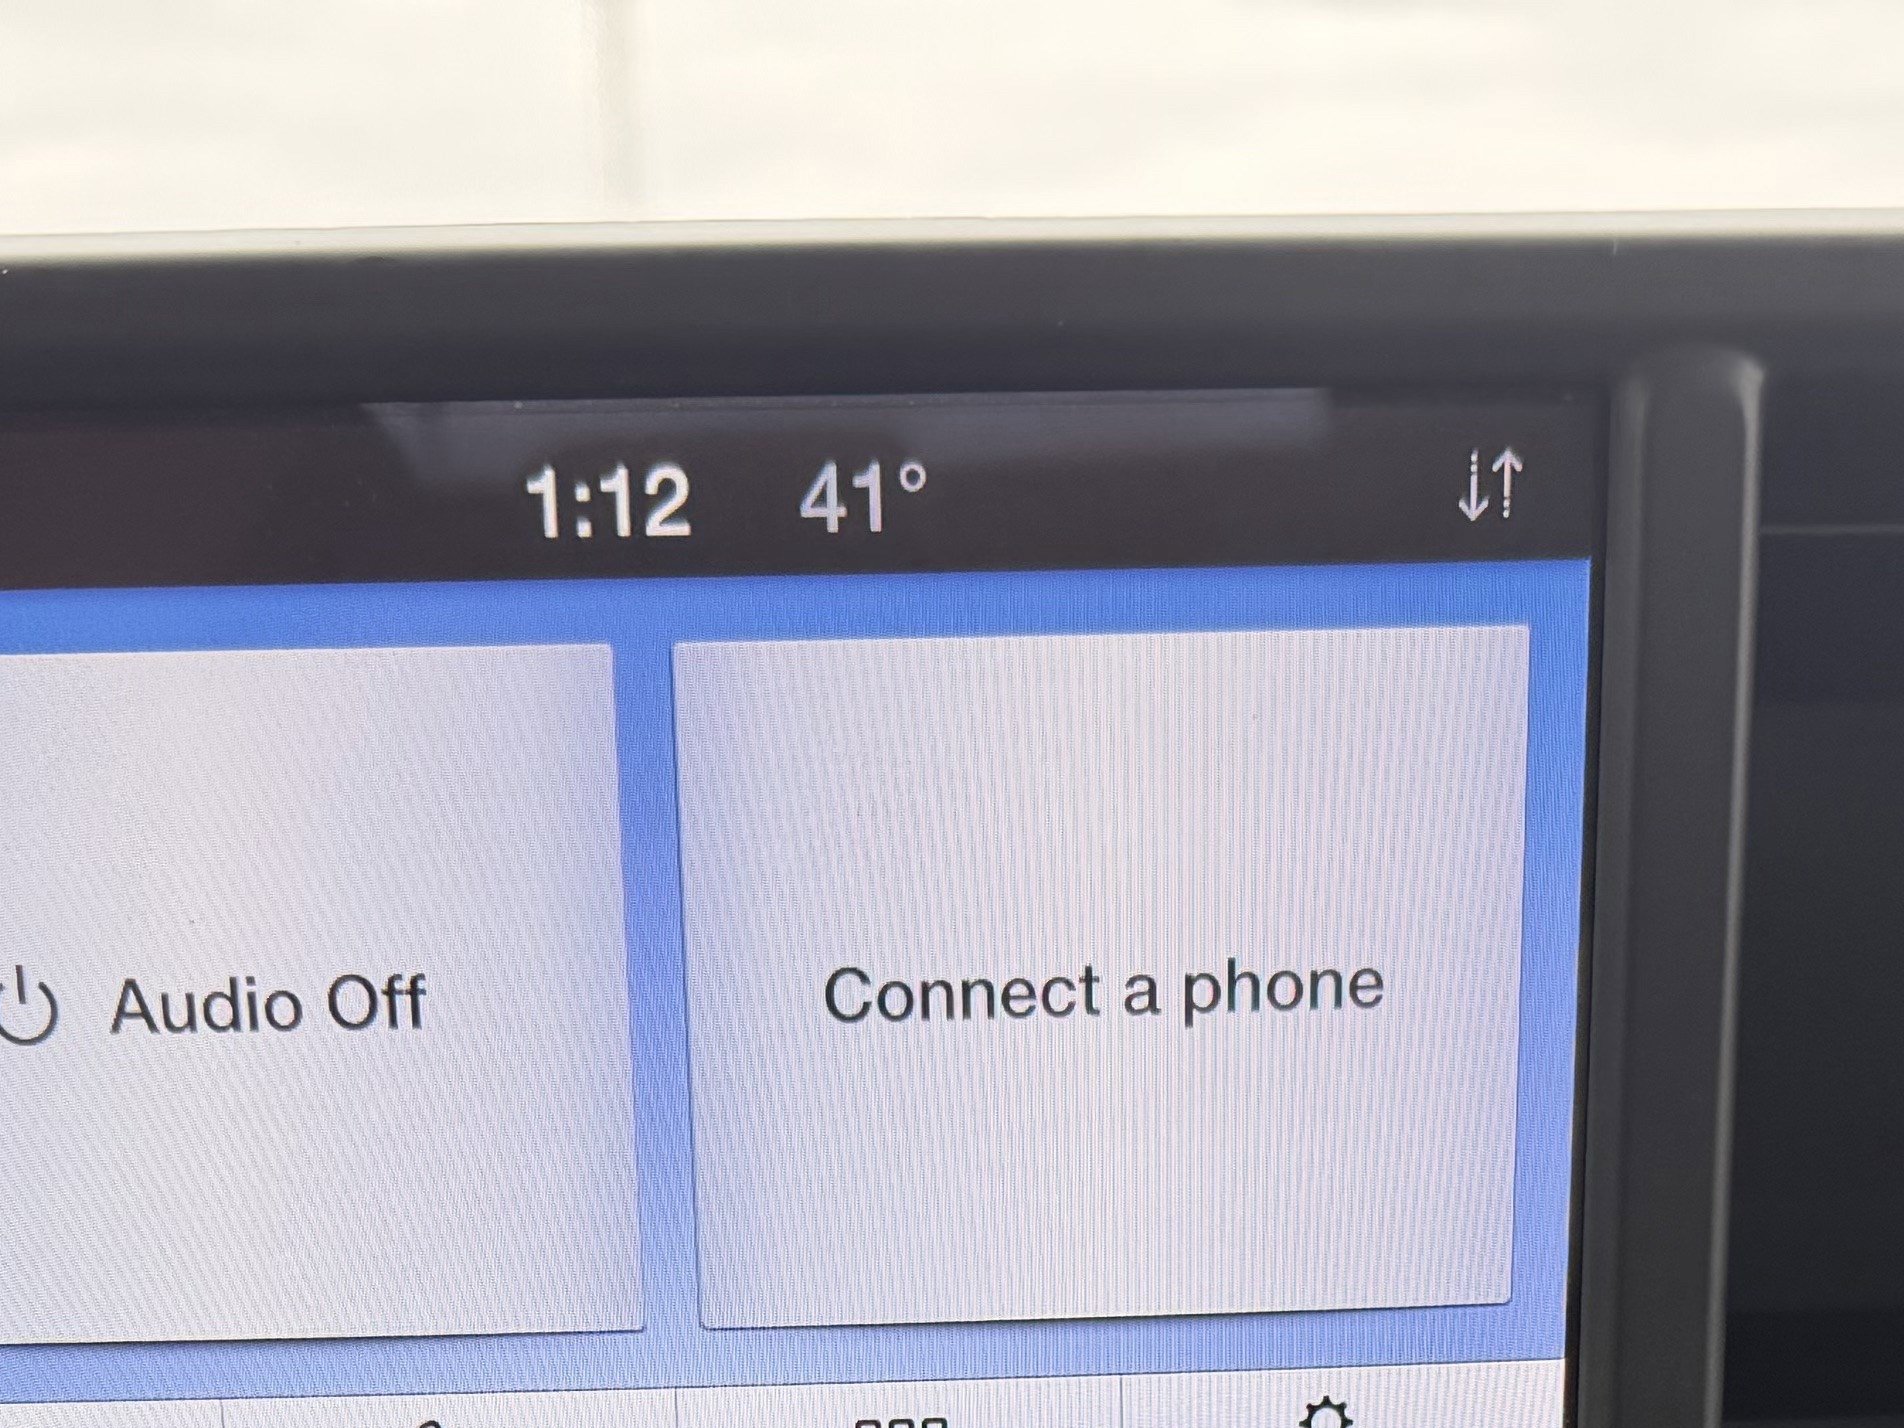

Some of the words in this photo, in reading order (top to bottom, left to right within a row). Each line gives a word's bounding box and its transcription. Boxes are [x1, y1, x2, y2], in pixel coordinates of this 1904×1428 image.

[526, 461, 691, 538] 1:12
[800, 458, 927, 533] 41°
[109, 974, 304, 1036] Audio
[327, 972, 428, 1032] Off
[824, 964, 1100, 1023] Connect
[1123, 973, 1162, 1018] a
[1182, 956, 1385, 1028] phone
